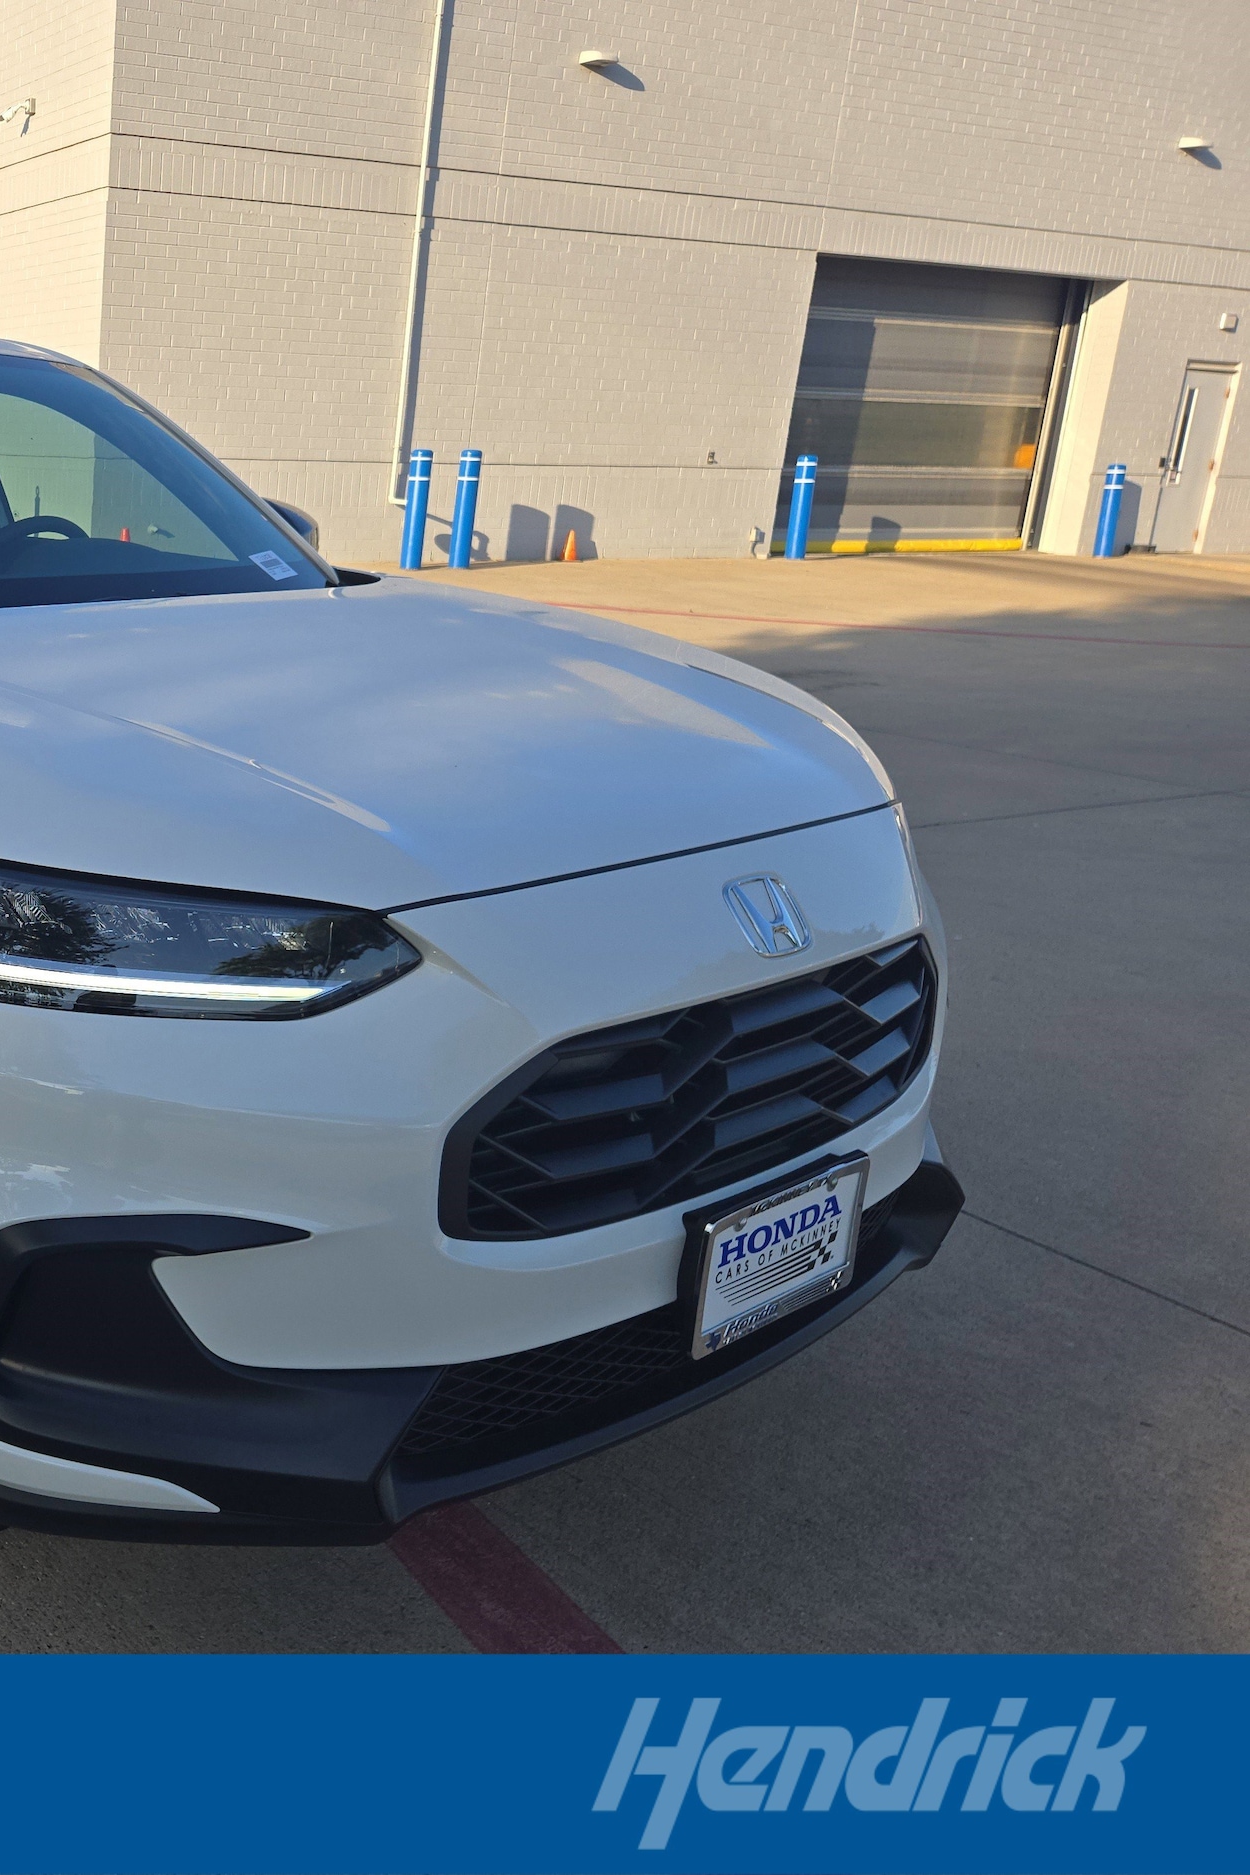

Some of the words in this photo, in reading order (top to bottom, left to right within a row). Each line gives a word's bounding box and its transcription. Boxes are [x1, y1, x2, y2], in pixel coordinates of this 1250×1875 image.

[715, 1257, 749, 1284] CARS
[758, 1249, 774, 1266] OF
[780, 1218, 842, 1256] MCKINNEY
[717, 1194, 842, 1268] HONDA
